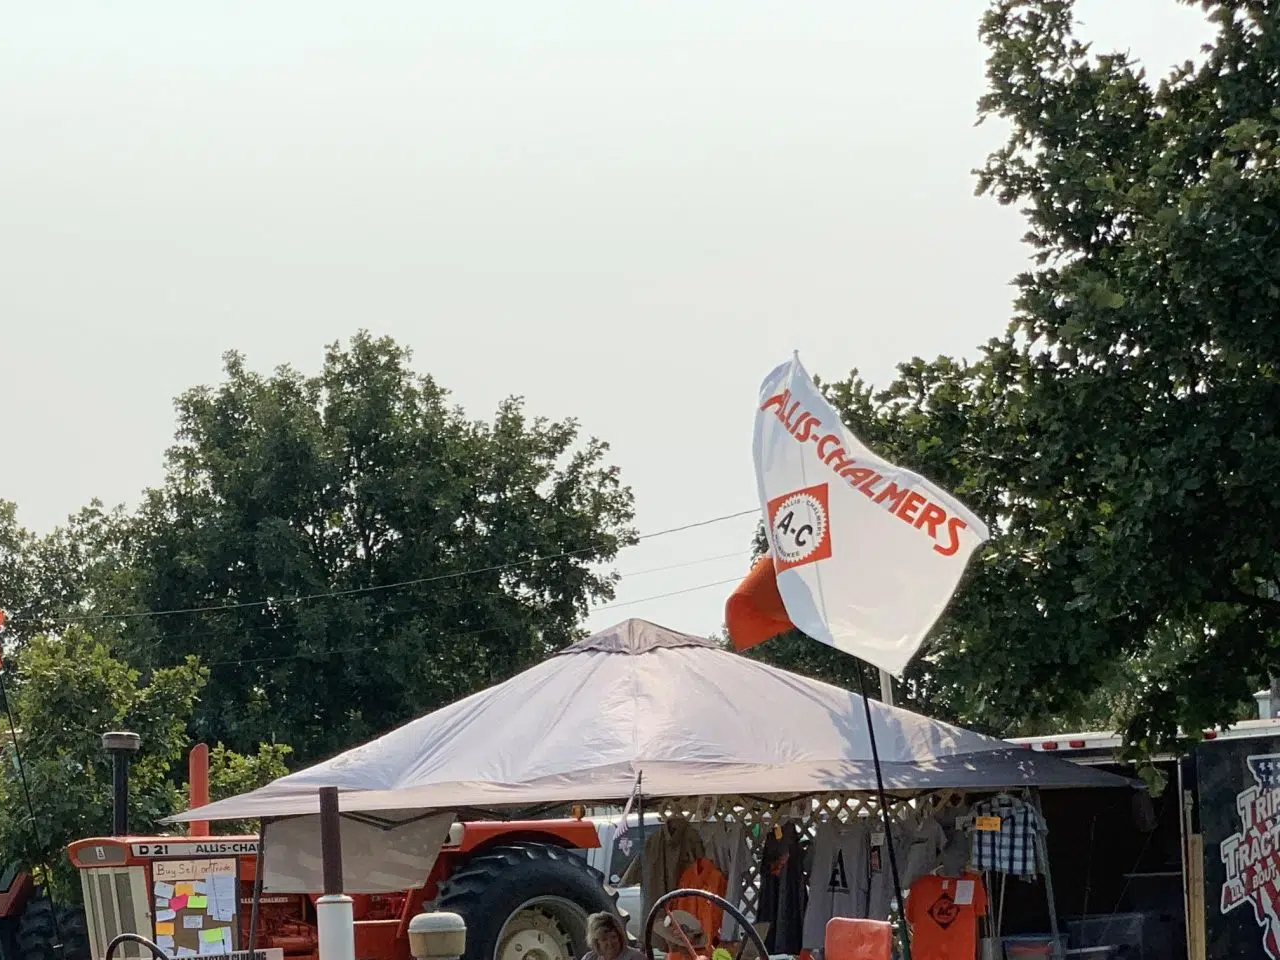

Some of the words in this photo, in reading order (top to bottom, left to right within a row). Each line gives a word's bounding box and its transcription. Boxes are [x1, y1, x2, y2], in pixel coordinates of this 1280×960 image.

[760, 388, 968, 557] ALLIS-CHALMERS
[776, 510, 813, 547] A-C
[138, 845, 149, 855] D
[154, 845, 169, 855] 21
[156, 863, 176, 877] Buy
[178, 863, 197, 875] Sell
